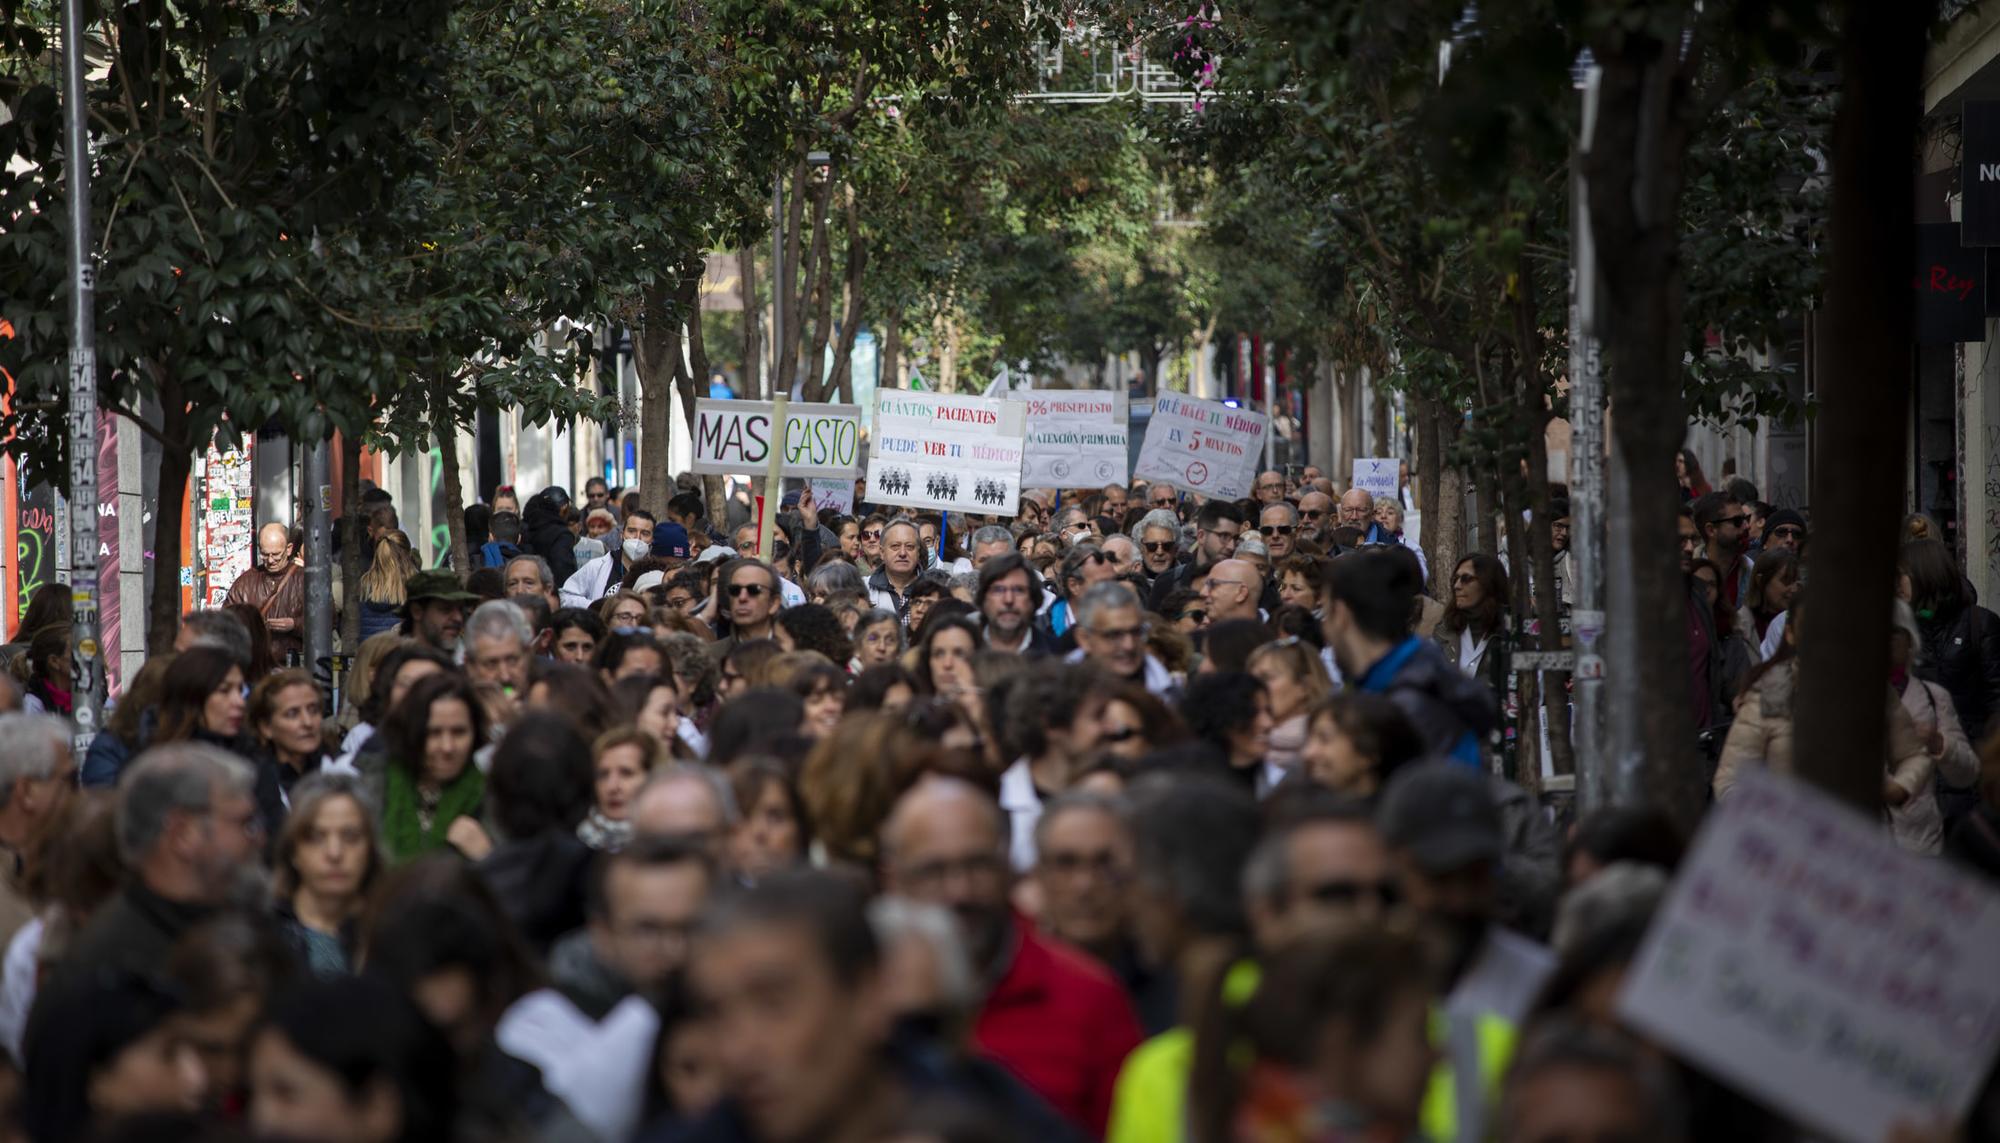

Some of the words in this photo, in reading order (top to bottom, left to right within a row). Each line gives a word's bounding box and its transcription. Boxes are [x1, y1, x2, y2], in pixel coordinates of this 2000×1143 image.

[69, 365, 92, 392] 54
[937, 406, 997, 425] PACIENTES
[1050, 401, 1113, 414] PRESUPUESTO
[70, 412, 93, 439] 54
[1210, 411, 1221, 426] TU
[1224, 415, 1262, 436] MÉDICO
[697, 413, 769, 462] MAS
[784, 417, 857, 466] GASTO
[881, 437, 918, 453] PUEDE
[924, 440, 946, 457] VER
[949, 443, 964, 458] TU
[1081, 433, 1126, 445] PRIMARIA
[1168, 428, 1182, 443] EN
[1188, 430, 1202, 451] 5
[1204, 436, 1243, 456] MINUTOS
[71, 458, 95, 486] 54
